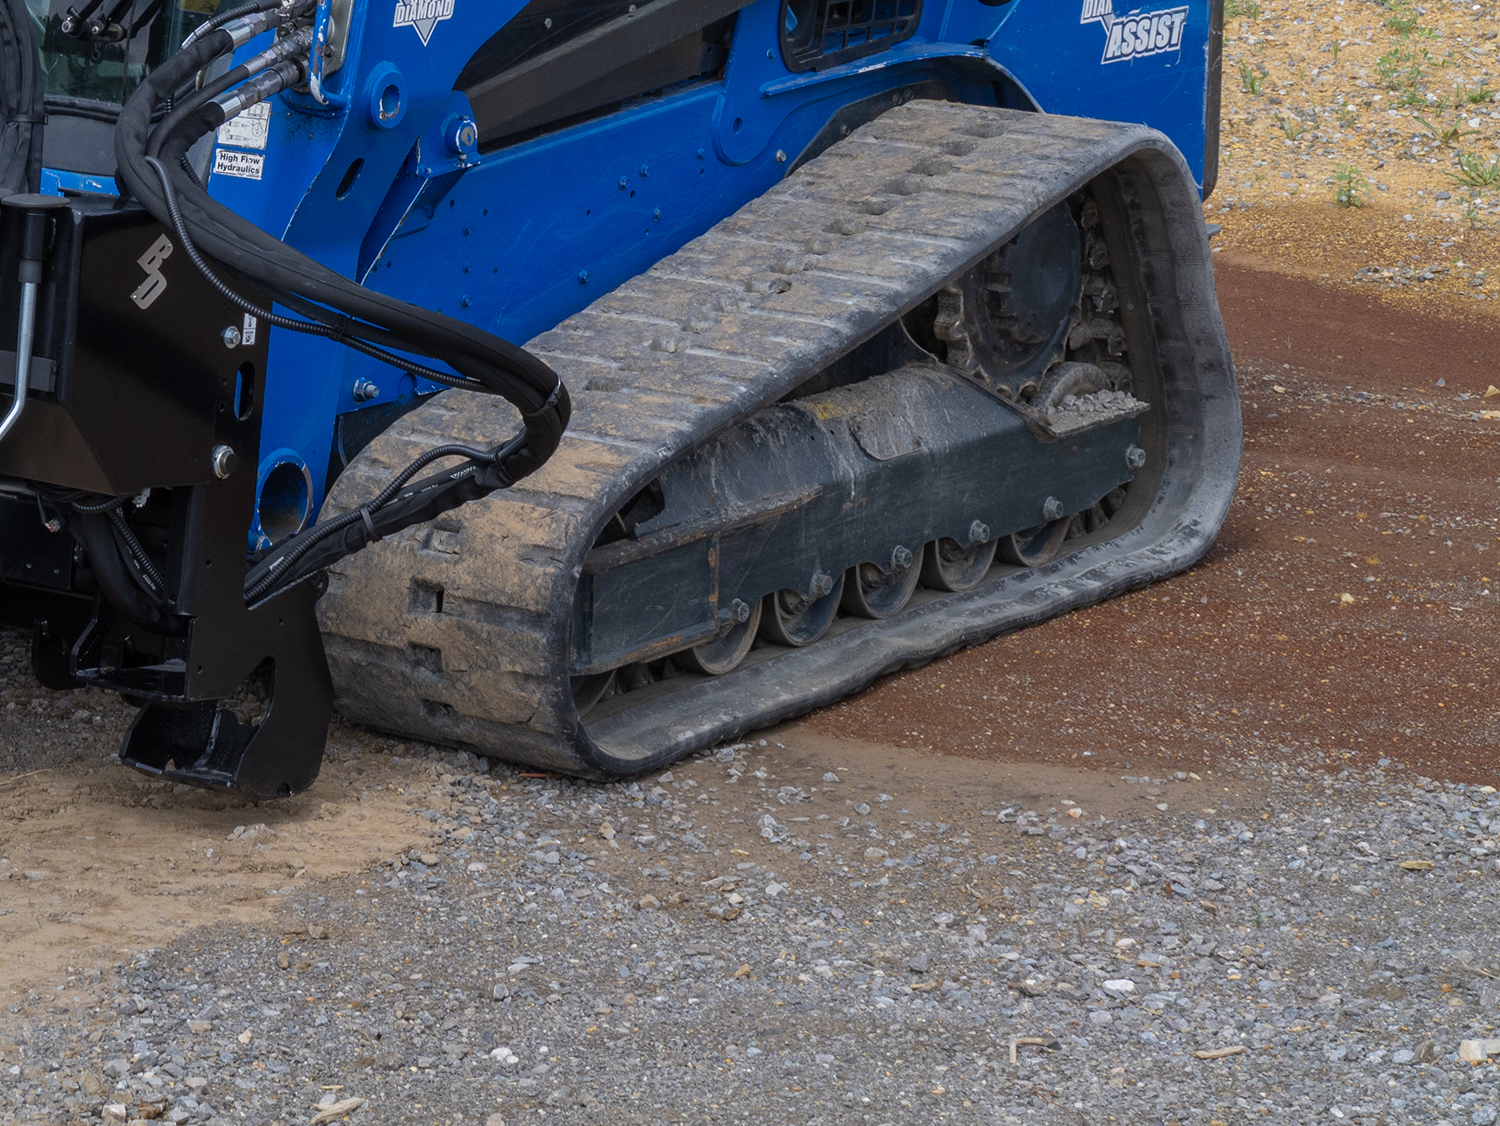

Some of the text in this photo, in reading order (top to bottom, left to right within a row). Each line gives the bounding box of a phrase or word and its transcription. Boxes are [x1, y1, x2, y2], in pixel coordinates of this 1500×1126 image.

[396, 0, 452, 23] DIAMOND
[1105, 12, 1185, 59] ASSIST
[220, 152, 238, 163] High
[217, 162, 260, 174] Hydraulics
